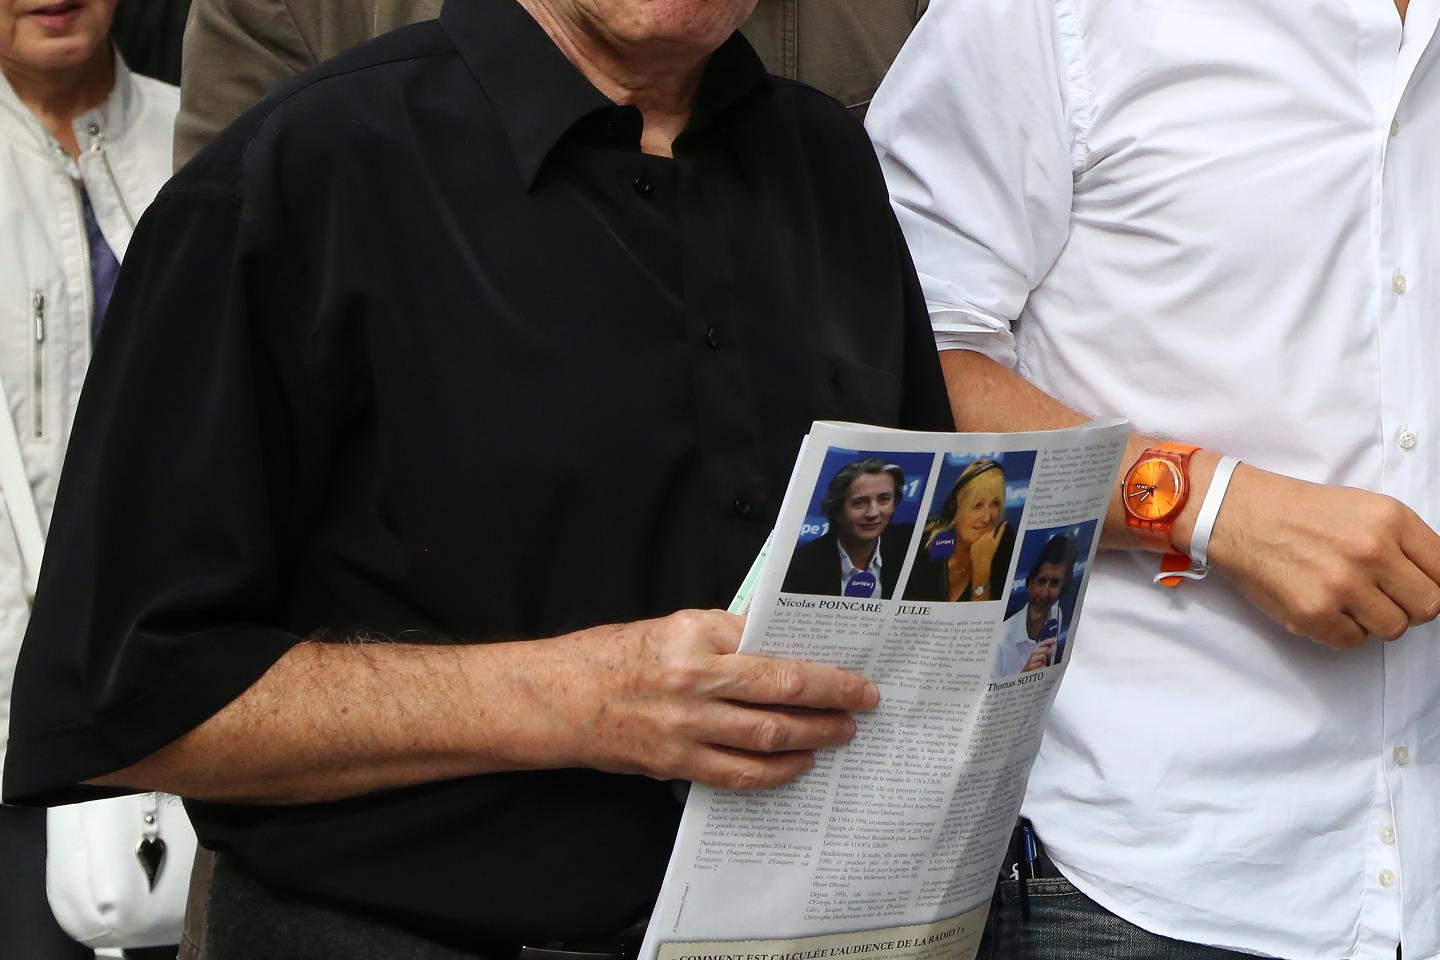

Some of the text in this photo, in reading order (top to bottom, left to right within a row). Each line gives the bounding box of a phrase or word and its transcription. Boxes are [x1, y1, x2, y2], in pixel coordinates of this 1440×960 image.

[776, 597, 884, 613] Nicolas POINCARÉ
[894, 605, 931, 616] JULIE
[988, 672, 1044, 692] Thomas SOTTO
[830, 941, 895, 956] L'AUDIENCE
[896, 939, 912, 950] DE
[914, 937, 926, 947] LA
